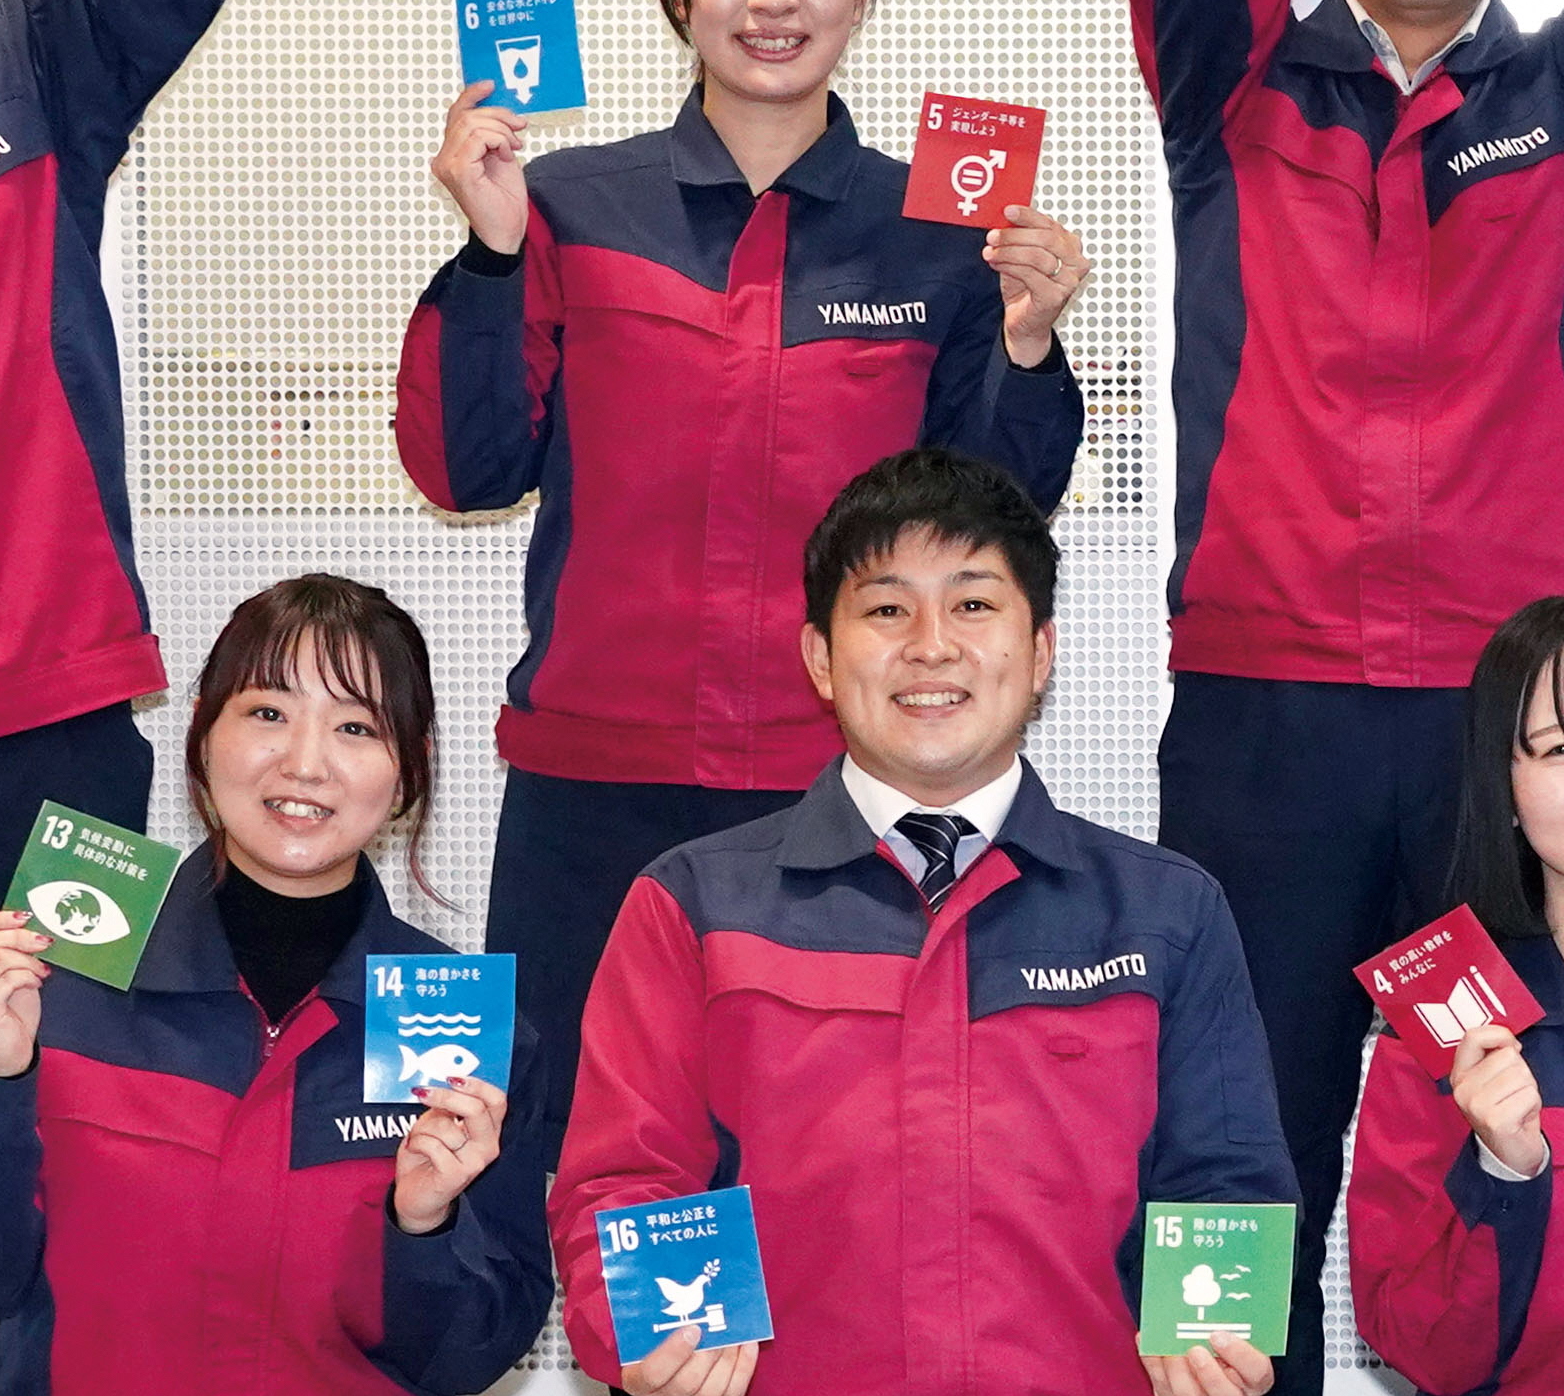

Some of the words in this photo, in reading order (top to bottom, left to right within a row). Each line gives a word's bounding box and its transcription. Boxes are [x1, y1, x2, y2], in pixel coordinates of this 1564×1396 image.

[464, 2, 480, 30] 6
[488, 11, 535, 27] を世界中に
[926, 103, 944, 130] 5
[950, 120, 997, 136] 実現しよう
[952, 106, 1026, 128] ジェンダー平等を
[1446, 126, 1551, 176] YAMAMOTO
[817, 301, 927, 326] YAMAMOTO
[41, 815, 74, 850] 13
[78, 827, 137, 858] 気候変動に
[72, 843, 149, 881] 具体的な対策を
[1388, 930, 1454, 973] 質の高い教育を
[373, 966, 405, 998] 14
[414, 967, 482, 982] 海の豊かさを
[1020, 953, 1147, 991] YAMAMOTO
[1372, 968, 1394, 995] 4
[1398, 957, 1437, 985] みんなに
[415, 984, 448, 998] 守ろう
[334, 1113, 417, 1142] YAMAM
[646, 1205, 717, 1228] 平和と公正を
[1193, 1217, 1259, 1233] 陸の豊かさも
[605, 1217, 640, 1254] 16
[649, 1223, 719, 1246] すべての人に
[1153, 1215, 1184, 1248] 15
[1193, 1234, 1225, 1248] 守ろう
